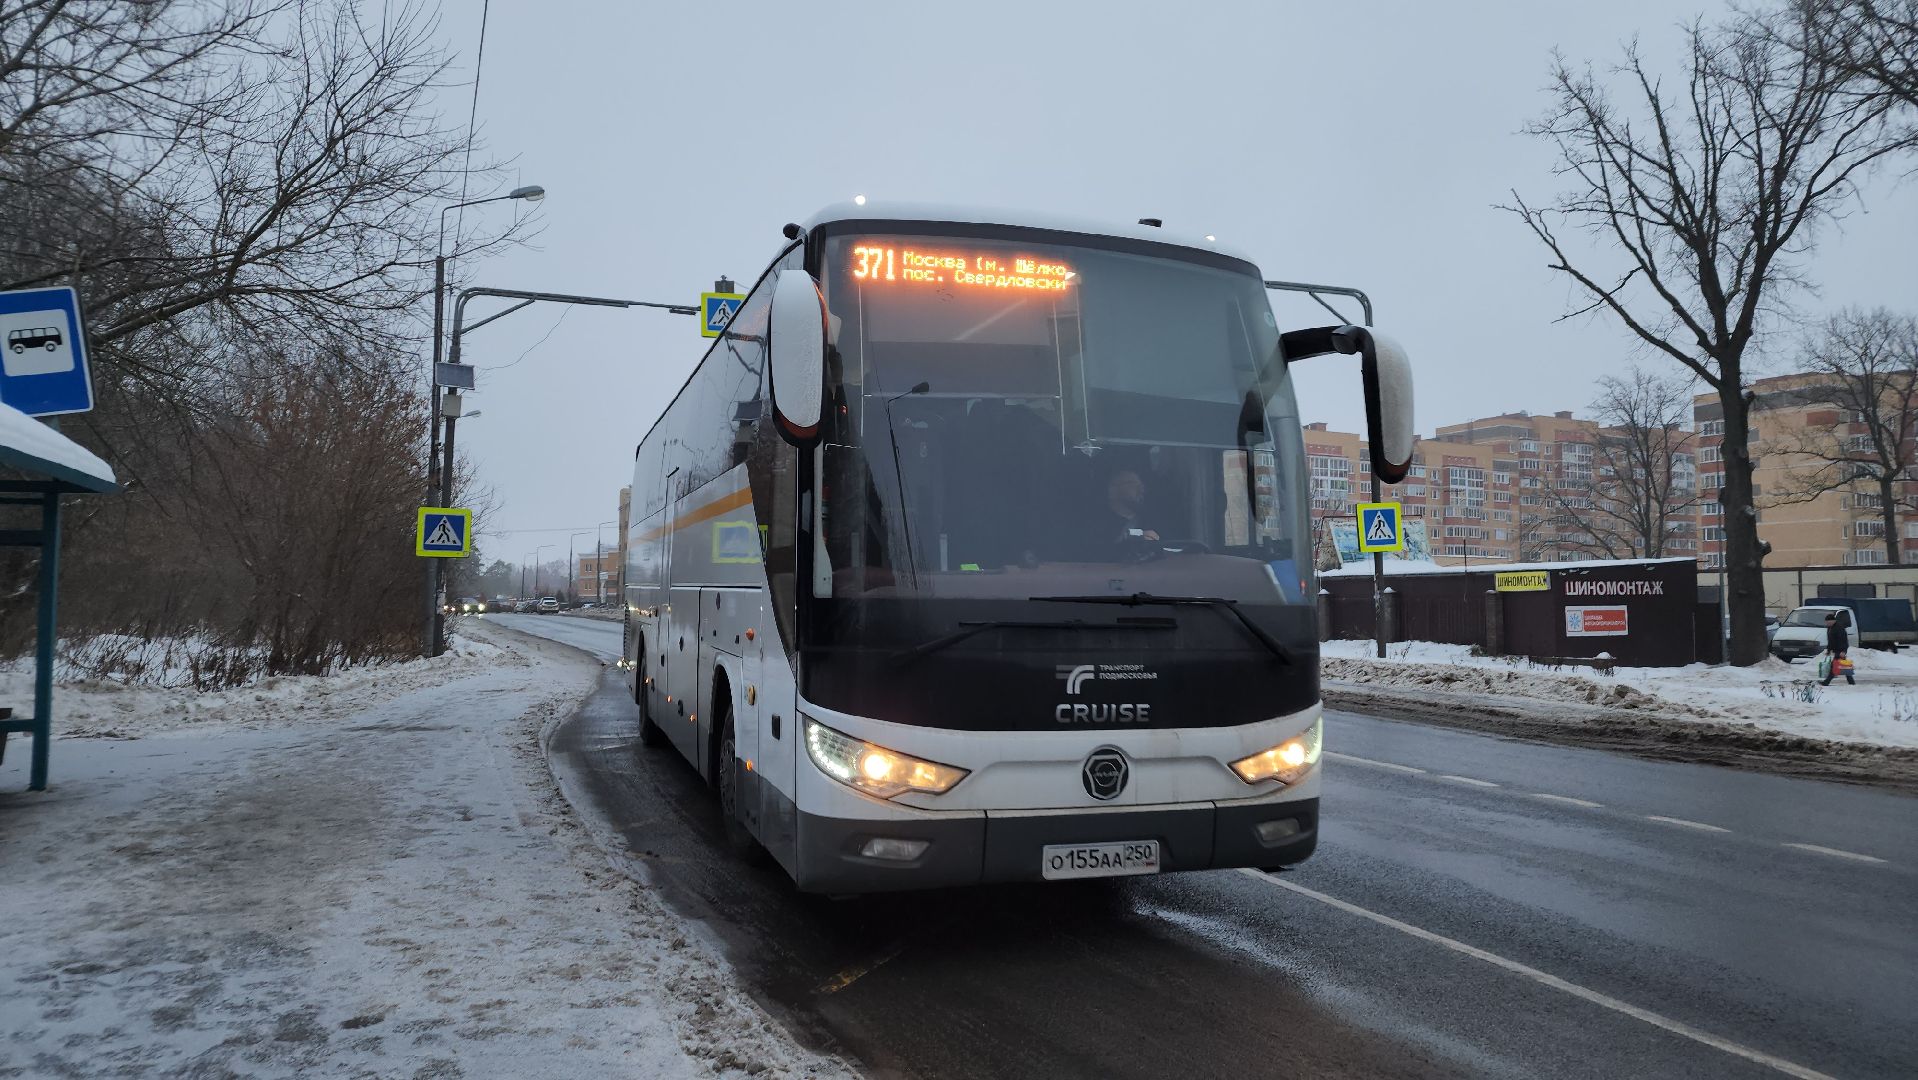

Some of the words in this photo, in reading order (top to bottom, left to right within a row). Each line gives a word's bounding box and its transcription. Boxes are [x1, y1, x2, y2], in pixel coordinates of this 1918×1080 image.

[853, 246, 895, 280] 371
[903, 251, 966, 270] Москва
[977, 257, 1005, 272] (м.
[903, 268, 944, 283] пос.
[1565, 581, 1662, 596] ШИНОМОНТАЖ
[1099, 664, 1144, 672] ТРАНСПОРТ
[1099, 672, 1158, 680] ПОДМОСКОВЬЯ
[1056, 703, 1150, 723] CRUISE
